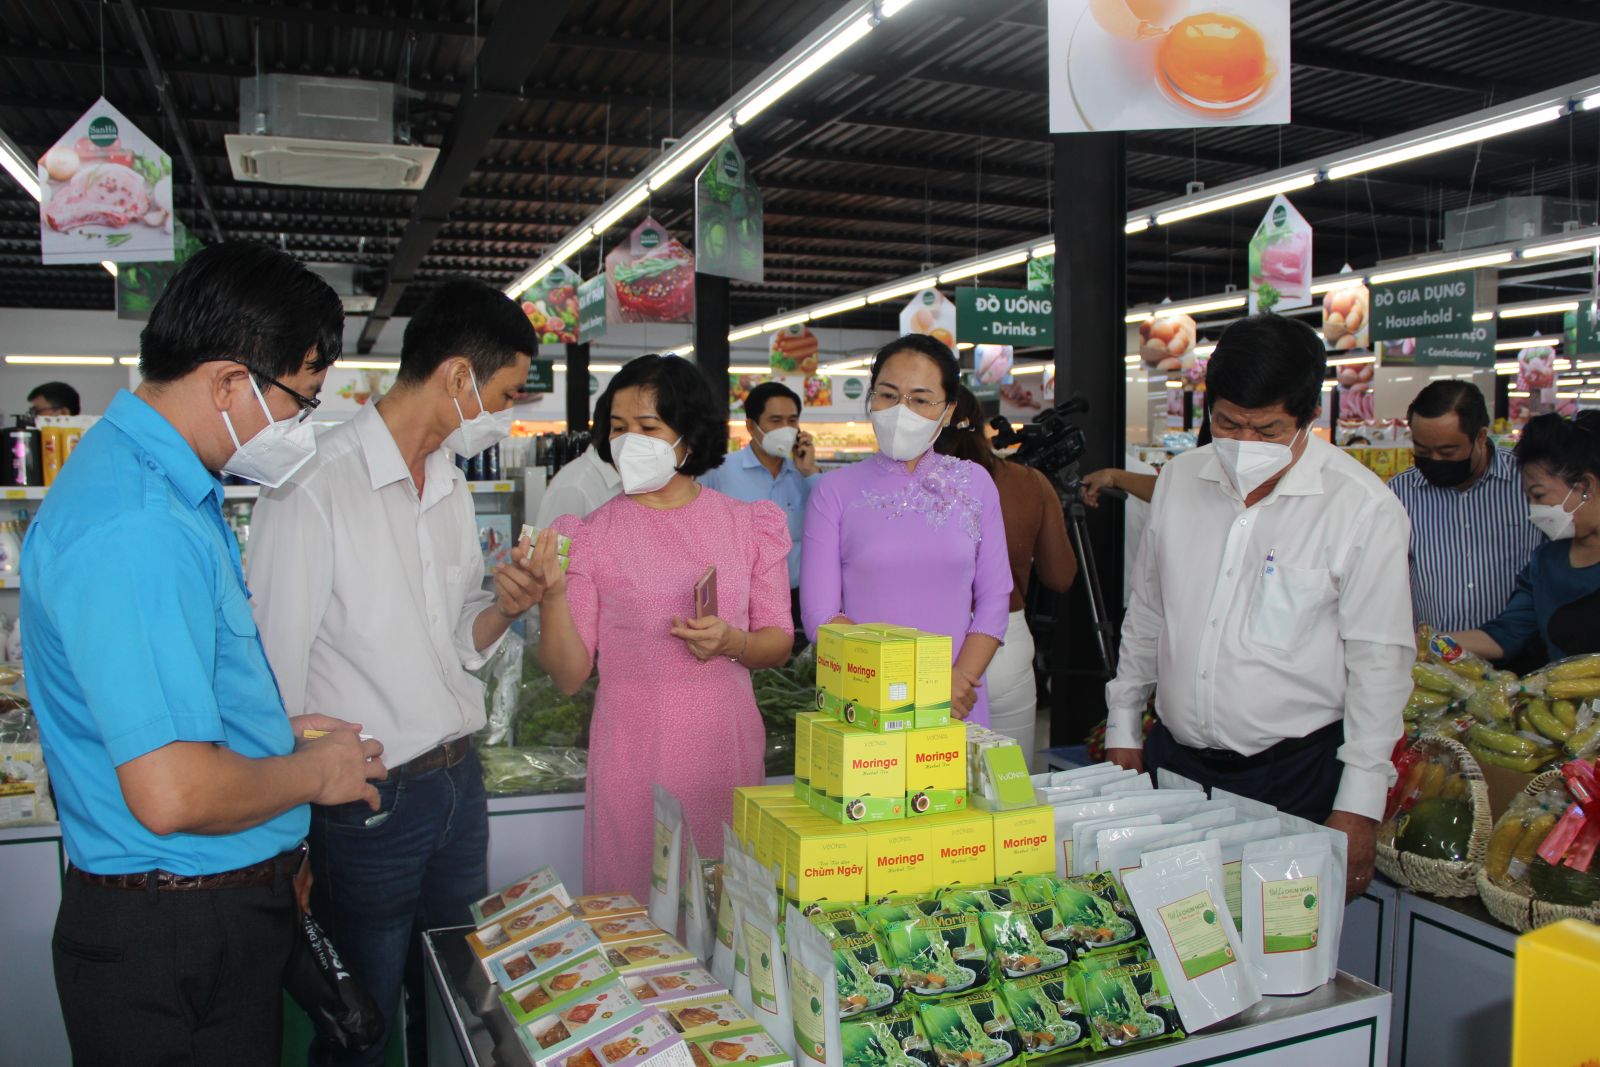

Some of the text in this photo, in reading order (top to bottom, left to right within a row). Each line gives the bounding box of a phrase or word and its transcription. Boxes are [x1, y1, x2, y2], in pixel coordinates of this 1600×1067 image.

[1374, 282, 1466, 307] ĐỒ GIA DỤNG
[975, 293, 1052, 315] ĐỒ UỐNG
[1385, 307, 1453, 329] Household
[992, 321, 1037, 336] Drinks
[847, 662, 876, 679] Moringa
[852, 758, 898, 769] Moringa
[915, 751, 959, 763] Moringa
[1003, 835, 1048, 849] Moringa
[940, 844, 986, 858] Moringa
[877, 853, 925, 867] Moringa
[804, 863, 864, 877] Chùm Ngây
